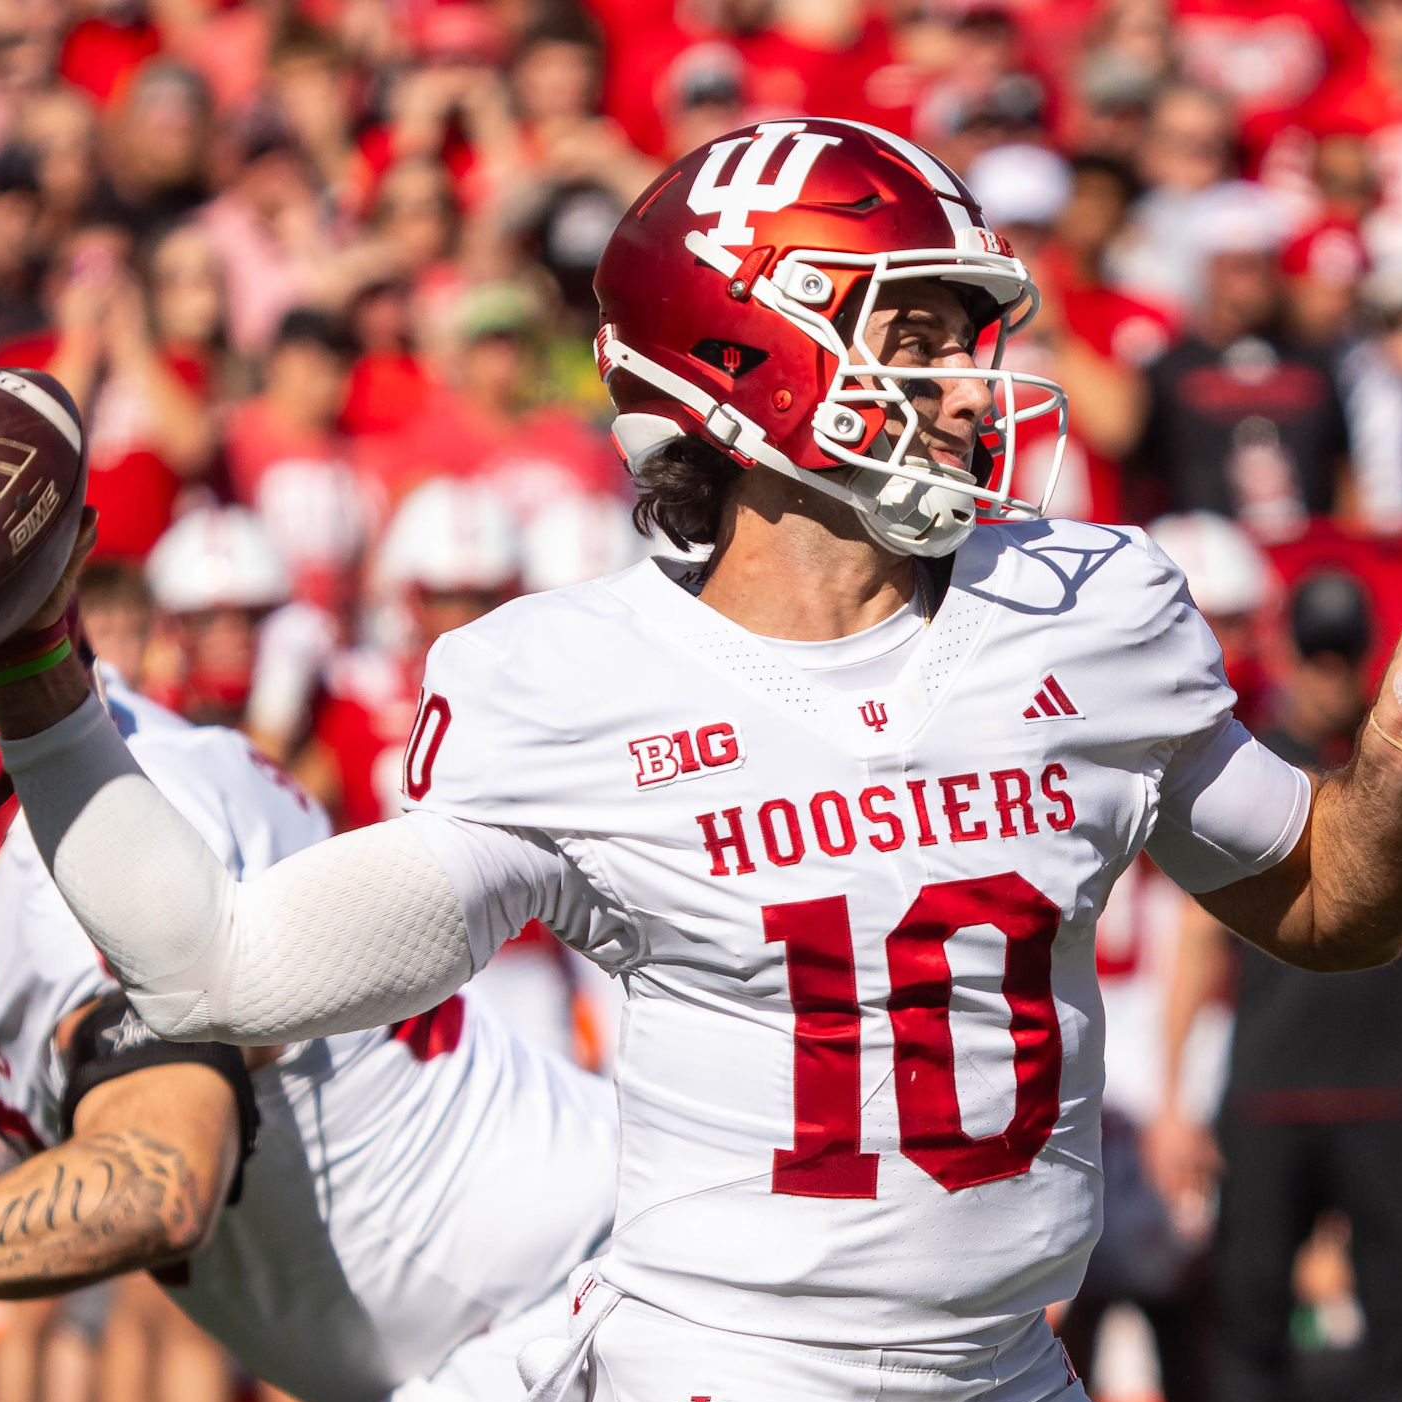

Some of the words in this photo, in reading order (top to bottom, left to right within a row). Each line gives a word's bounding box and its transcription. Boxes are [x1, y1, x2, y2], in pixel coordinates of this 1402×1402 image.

[8, 479, 60, 556] DIME
[402, 686, 452, 802] 0
[695, 762, 1076, 876] HOOSIERS
[761, 871, 1061, 1200] 10
